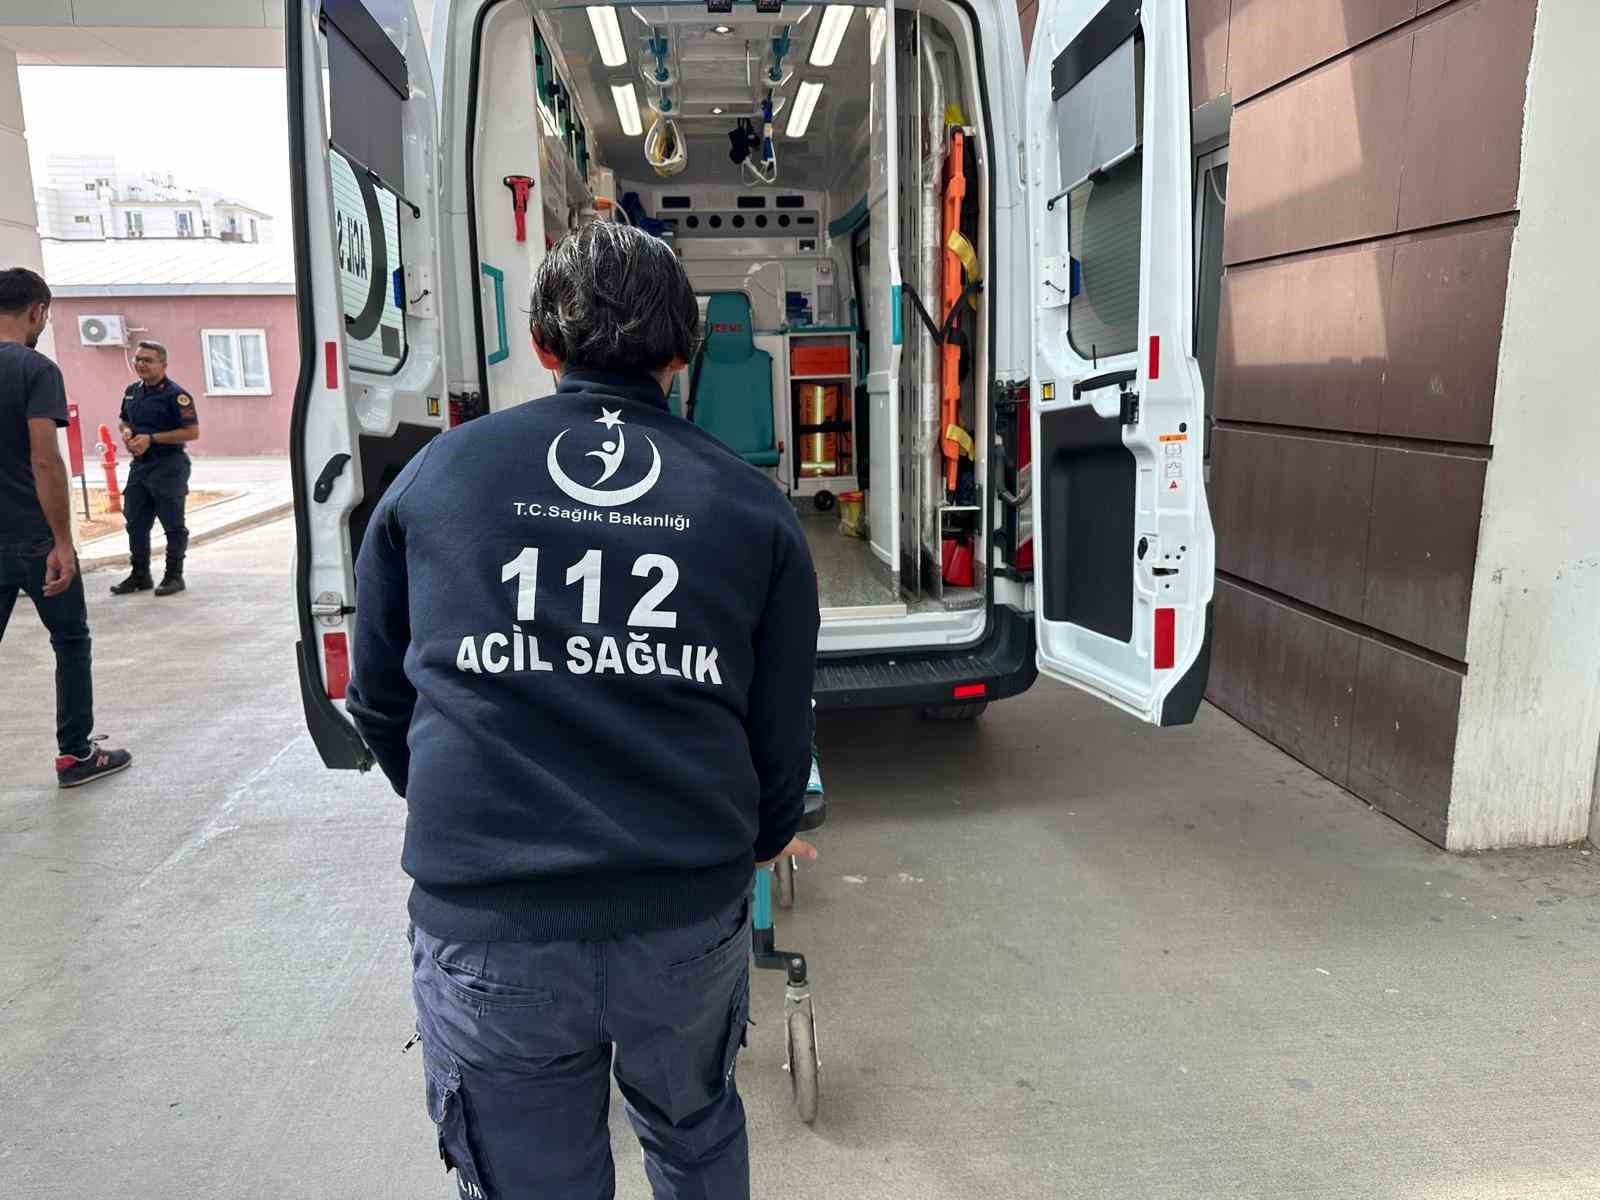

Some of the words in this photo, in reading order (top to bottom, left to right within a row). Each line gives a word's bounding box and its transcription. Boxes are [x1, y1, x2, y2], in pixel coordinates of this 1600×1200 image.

[609, 512, 690, 532] Bakanlığı
[456, 624, 553, 675] ACİL
[566, 631, 722, 685] SAĞLIK
